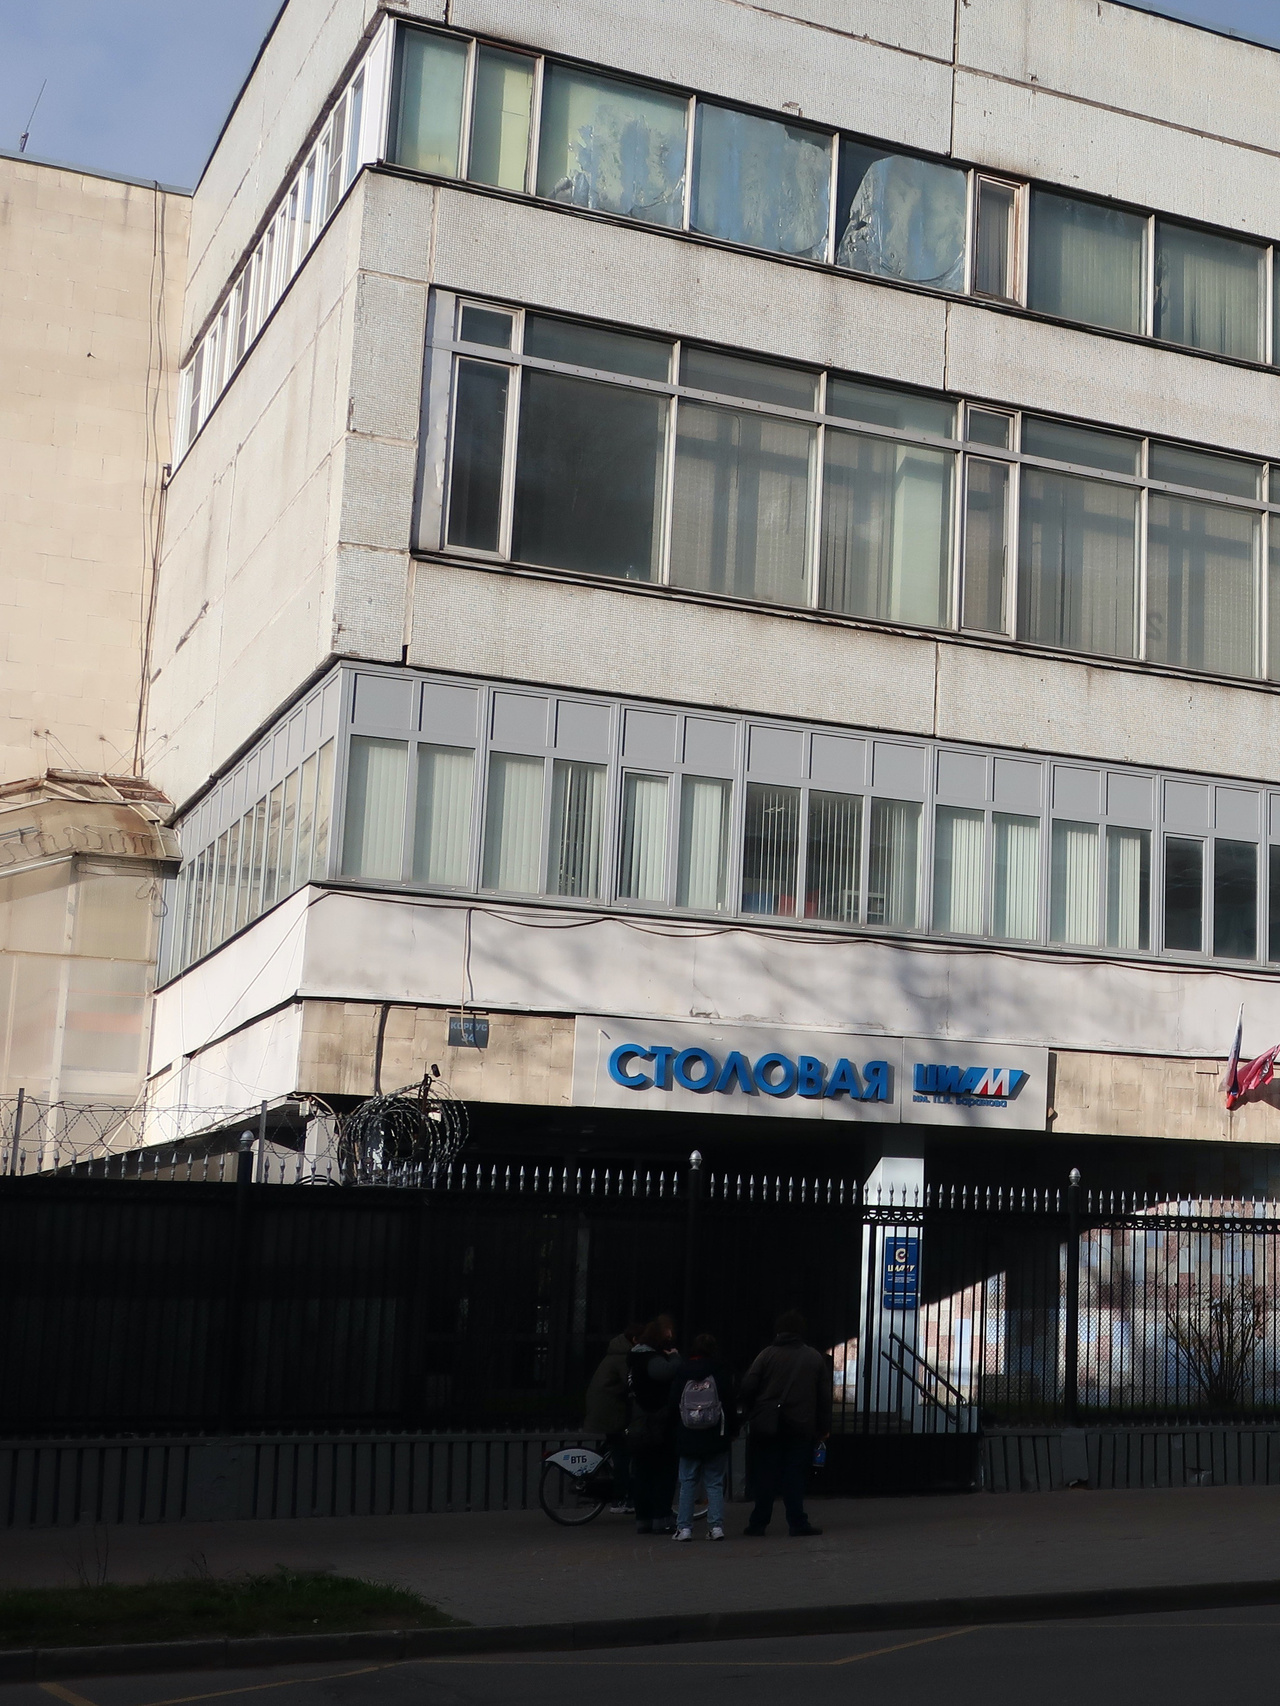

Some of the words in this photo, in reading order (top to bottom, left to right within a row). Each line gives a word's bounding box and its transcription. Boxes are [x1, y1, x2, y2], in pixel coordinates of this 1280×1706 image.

[607, 1043, 888, 1100] СТОЛОВАЯ
[913, 1063, 1014, 1096] ЦИАМ
[956, 1098, 1007, 1108] Баранова
[571, 1455, 587, 1464] ВТБ
